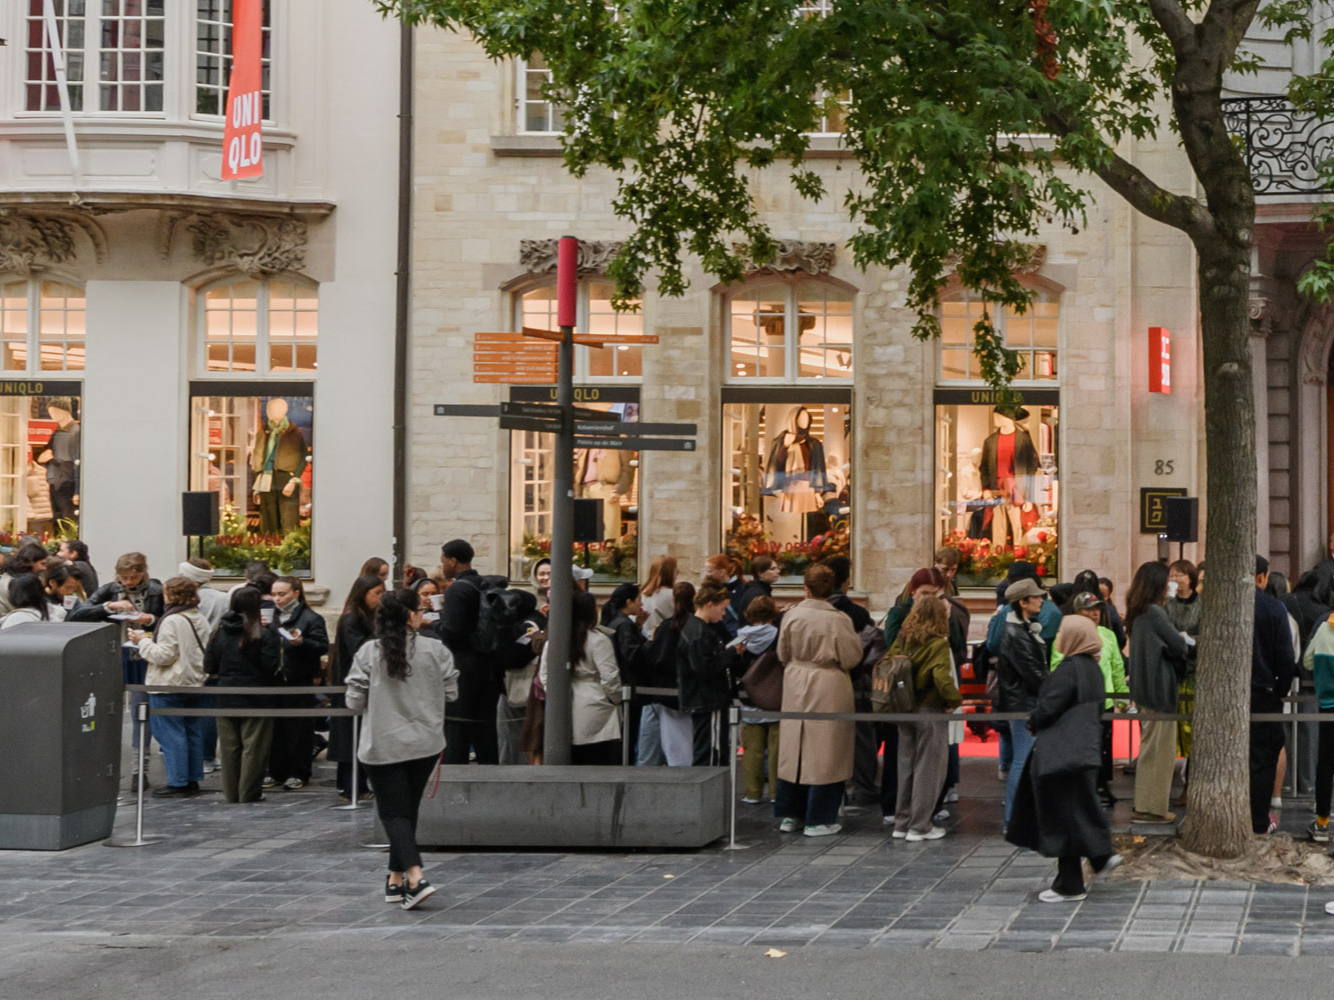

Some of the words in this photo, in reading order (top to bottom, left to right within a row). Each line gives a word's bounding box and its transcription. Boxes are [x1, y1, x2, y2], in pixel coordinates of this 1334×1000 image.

[233, 91, 260, 128] UNI
[228, 132, 261, 174] QLO
[550, 388, 599, 401] UQLO
[1154, 459, 1174, 475] 85
